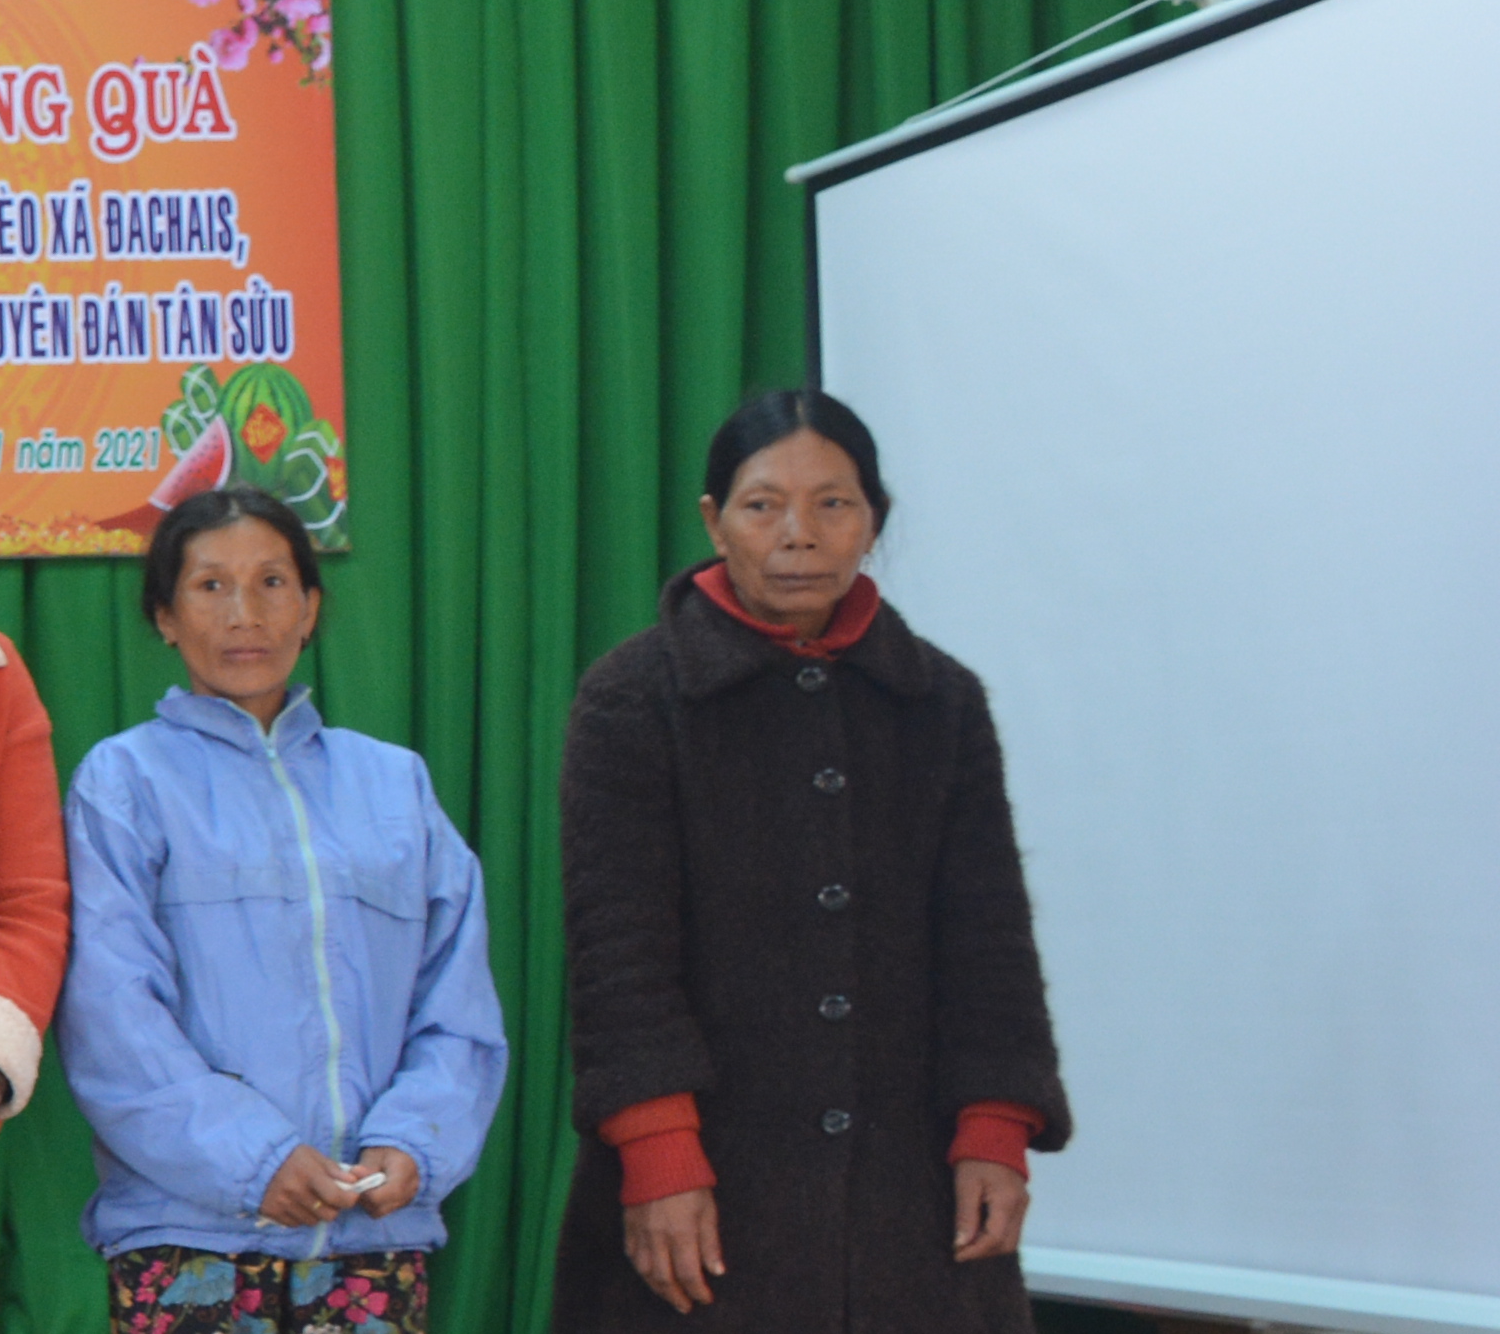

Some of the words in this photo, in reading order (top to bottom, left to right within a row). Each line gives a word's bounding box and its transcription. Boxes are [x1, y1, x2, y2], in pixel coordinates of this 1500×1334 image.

[91, 46, 234, 157] QUÀ
[48, 183, 93, 257] XÃ
[105, 192, 248, 264] ĐACHAIS,
[82, 284, 148, 360] ĐÁN
[157, 284, 218, 358] TÂN
[229, 278, 291, 358] SỬU
[17, 430, 83, 469] năm
[95, 430, 161, 468] 2021
